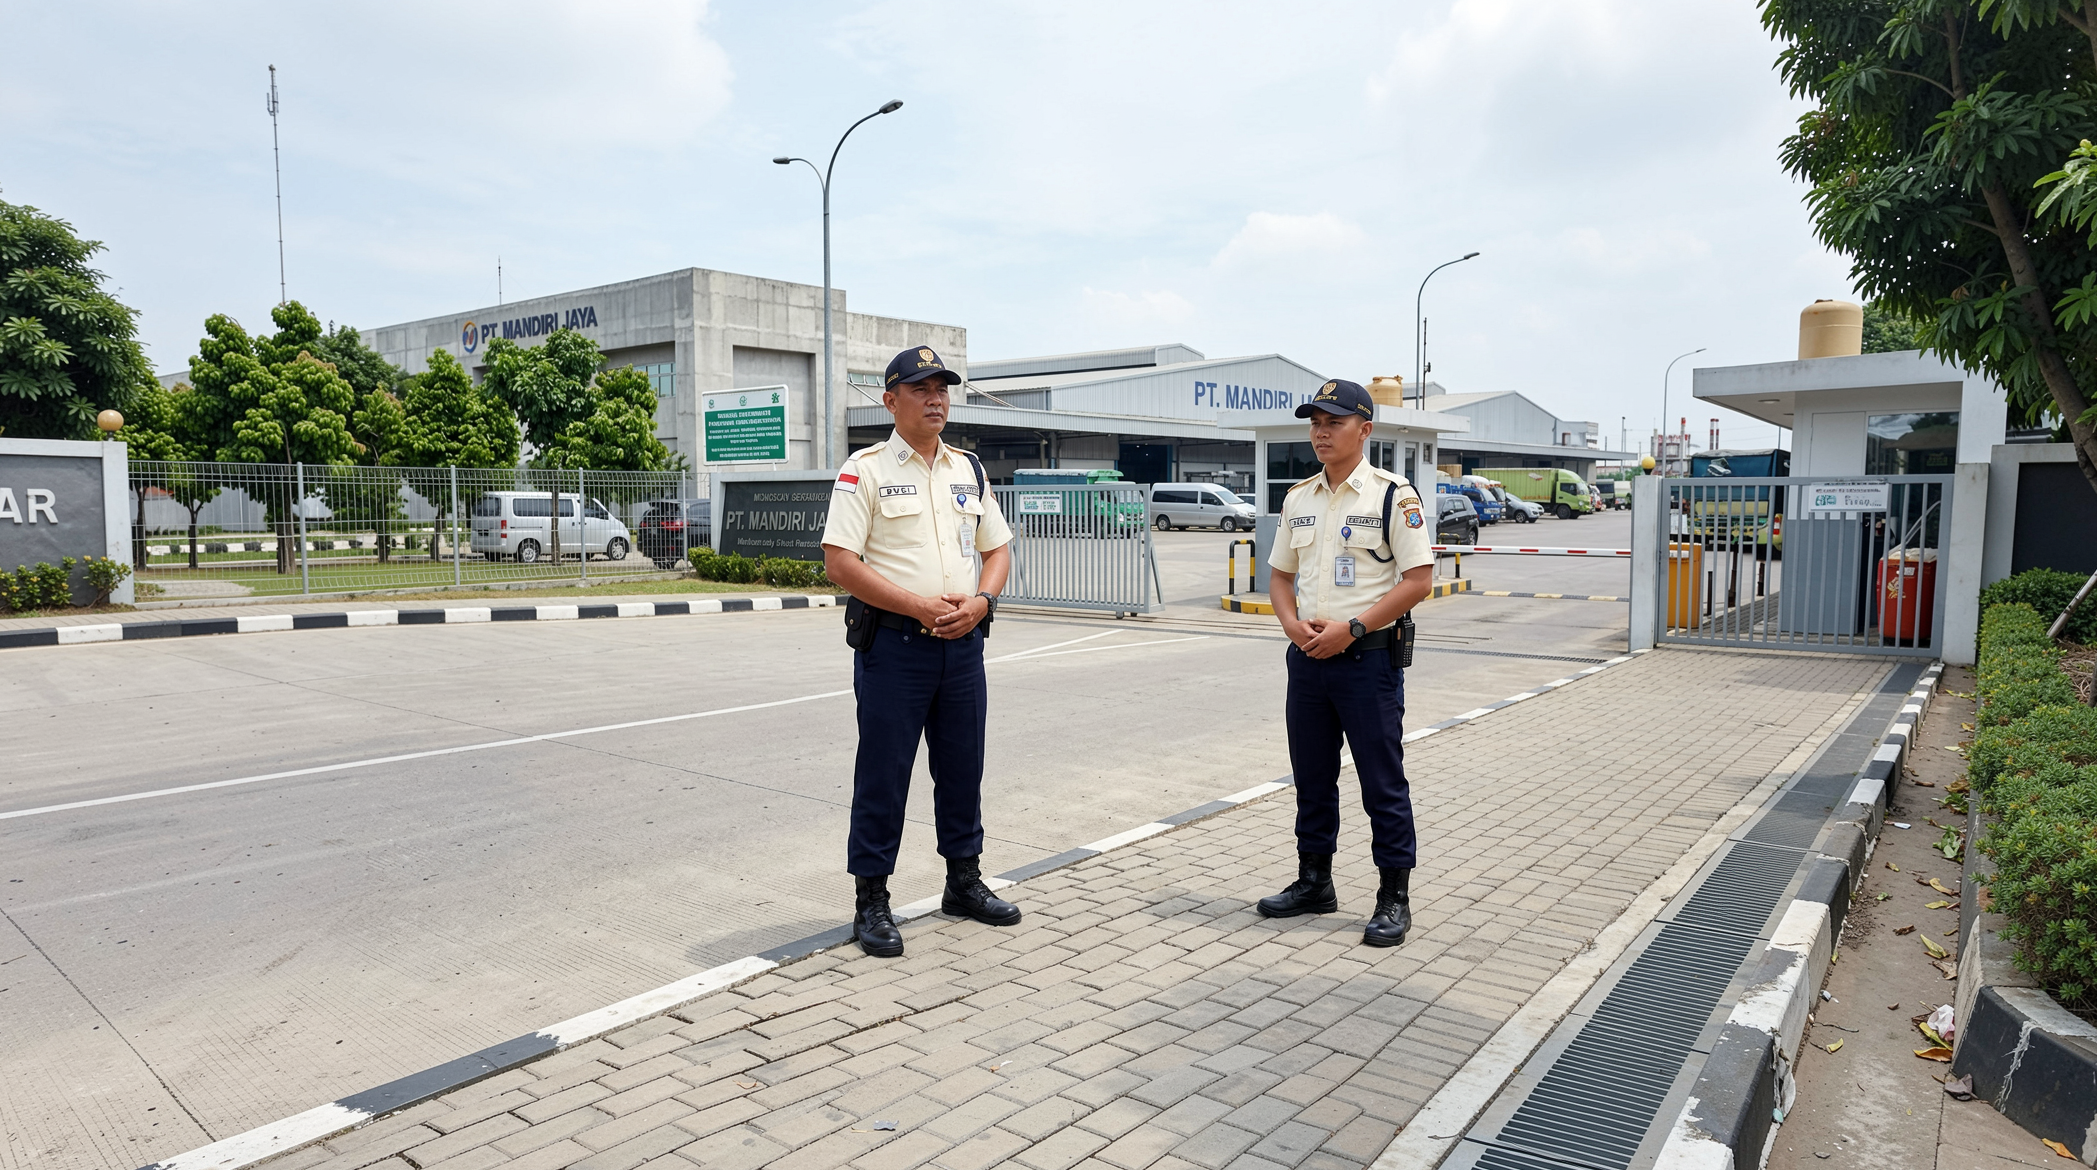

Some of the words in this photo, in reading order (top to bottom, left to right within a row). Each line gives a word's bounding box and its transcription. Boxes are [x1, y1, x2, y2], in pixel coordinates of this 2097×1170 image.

[481, 322, 498, 344] PT
[502, 312, 558, 340] MANDIRI
[562, 305, 598, 331] JAYA
[1194, 380, 1220, 408] PT.
[1225, 384, 1293, 411] MANDIRI
[0, 487, 59, 524] AR
[726, 511, 745, 530] PT.
[749, 511, 806, 531] MANDIRI
